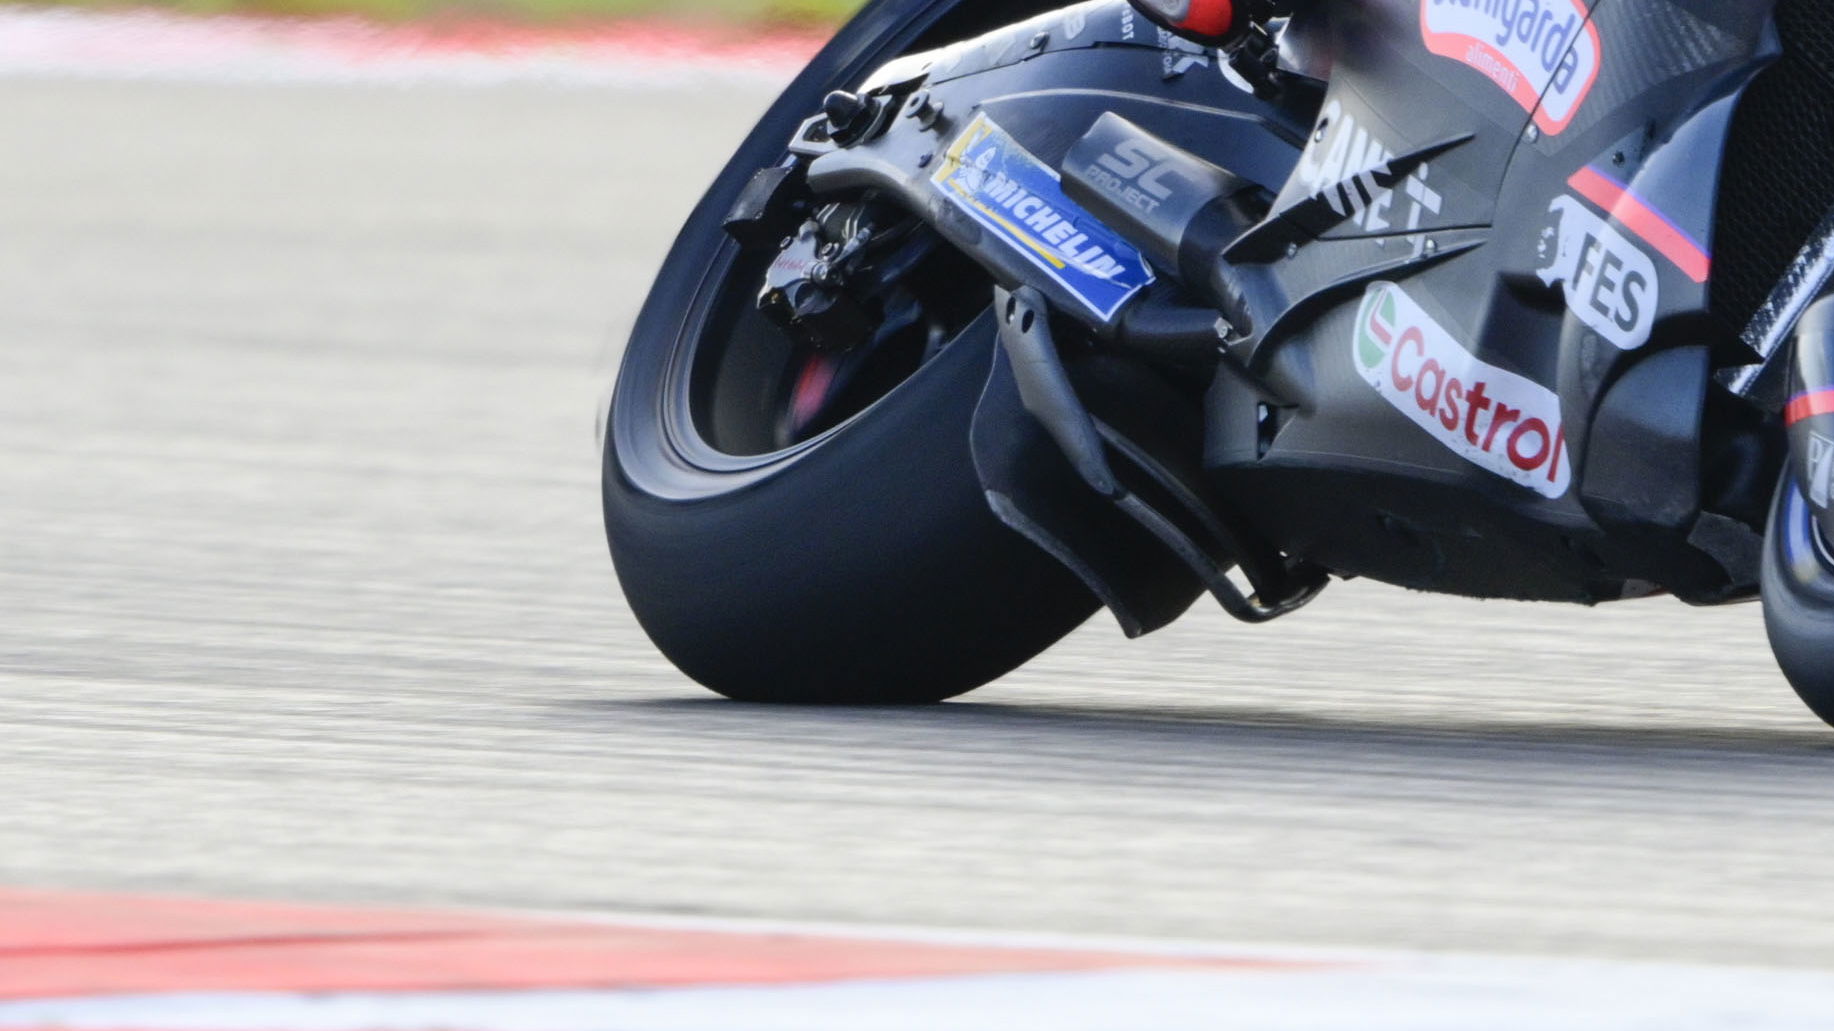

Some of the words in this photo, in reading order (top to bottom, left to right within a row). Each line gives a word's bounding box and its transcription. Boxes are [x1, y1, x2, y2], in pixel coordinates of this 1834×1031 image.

[1465, 43, 1521, 93] alimenti
[1084, 164, 1161, 214] PROJECT
[1096, 137, 1195, 199] SC
[984, 171, 1127, 280] MICHELIN
[1571, 231, 1648, 333] FES
[1391, 325, 1566, 483] Castrol
